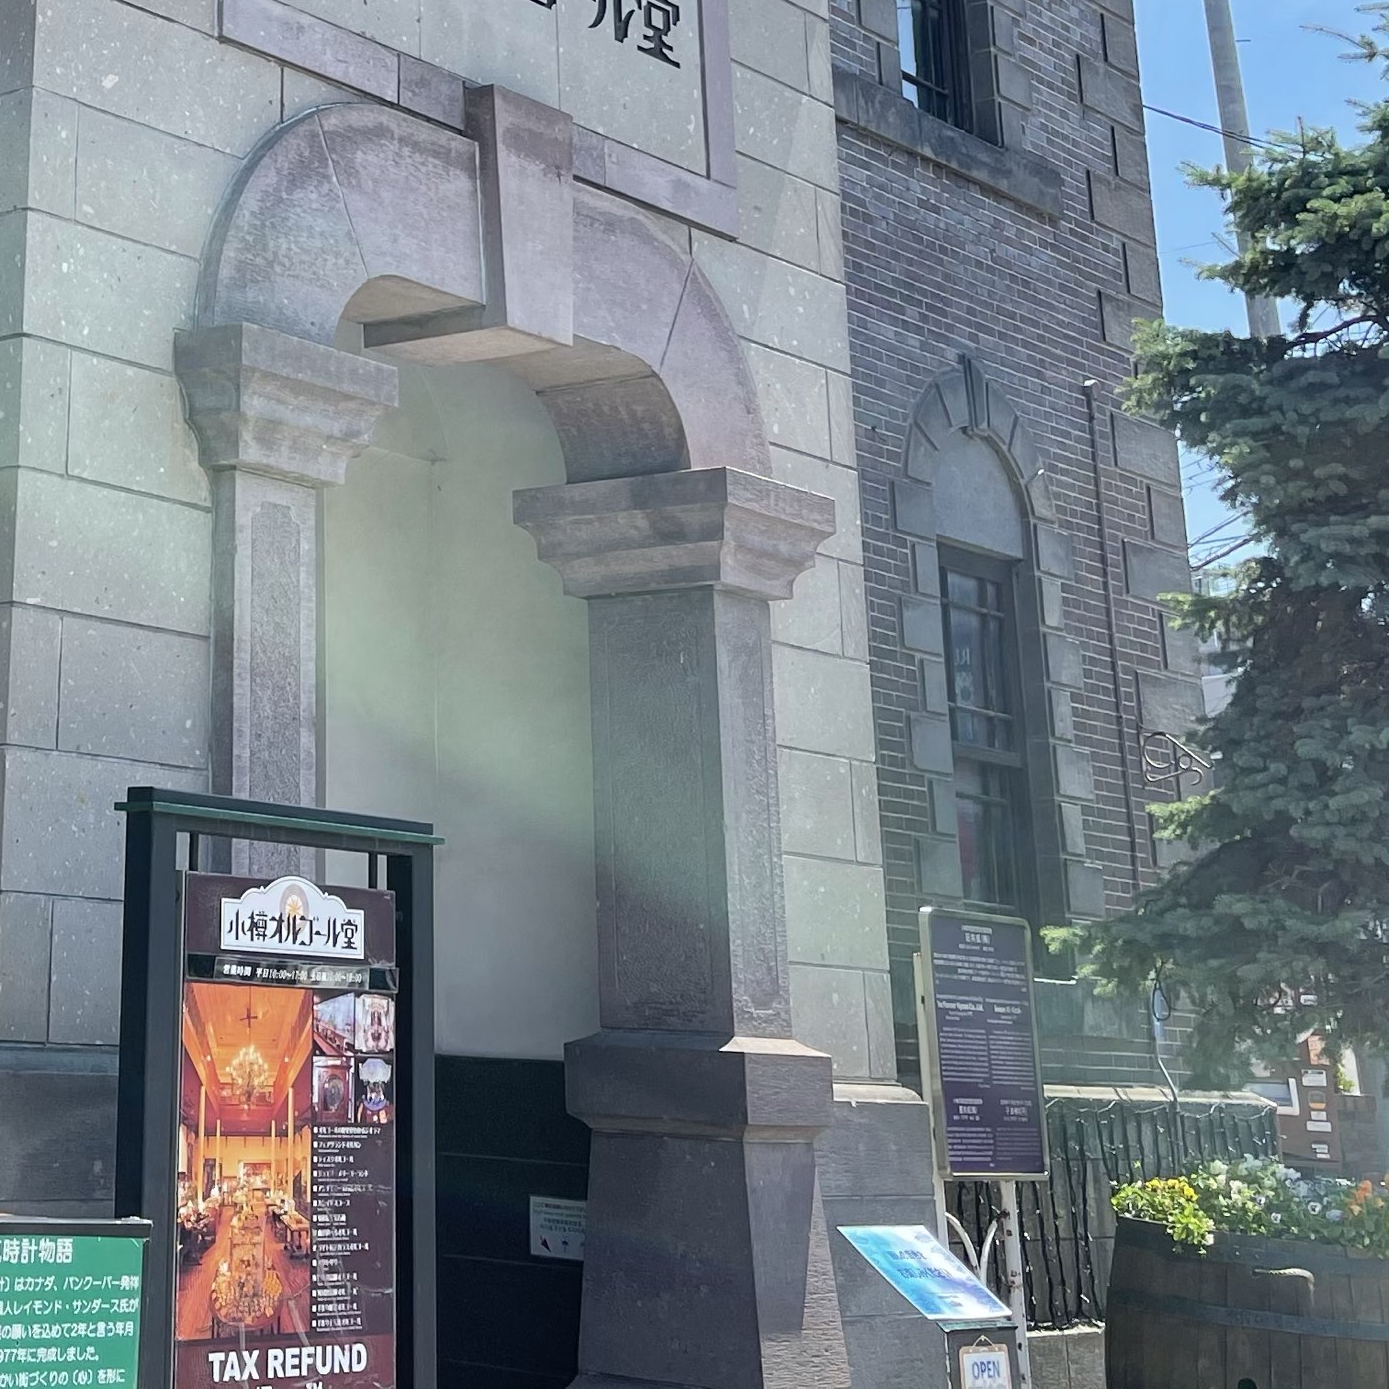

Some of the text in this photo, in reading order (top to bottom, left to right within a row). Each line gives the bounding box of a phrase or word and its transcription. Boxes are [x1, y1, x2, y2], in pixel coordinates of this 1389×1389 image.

[227, 909, 358, 950] 小樽オルゴール堂
[208, 1343, 368, 1382] TAX REFUND
[972, 1361, 1001, 1381] OPEN
